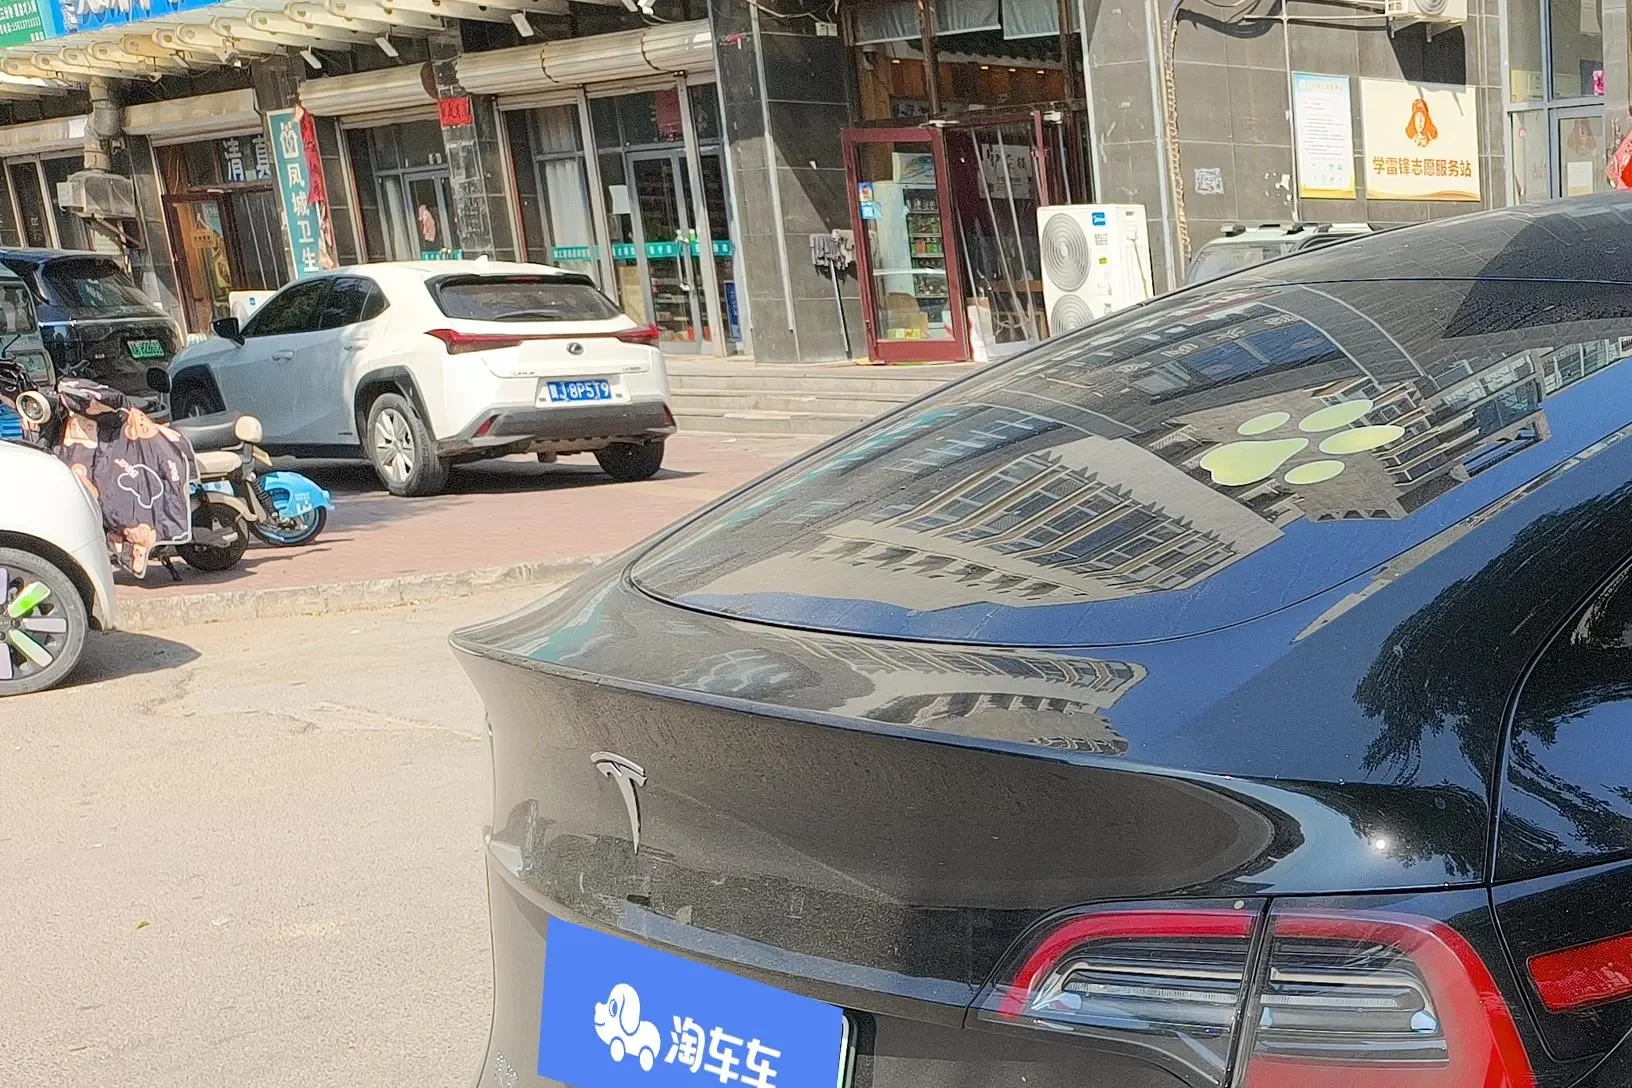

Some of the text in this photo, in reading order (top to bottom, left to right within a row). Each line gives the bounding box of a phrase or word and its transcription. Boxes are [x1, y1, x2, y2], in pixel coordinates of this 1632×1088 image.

[1373, 156, 1472, 178] 学雷锋志愿服务站
